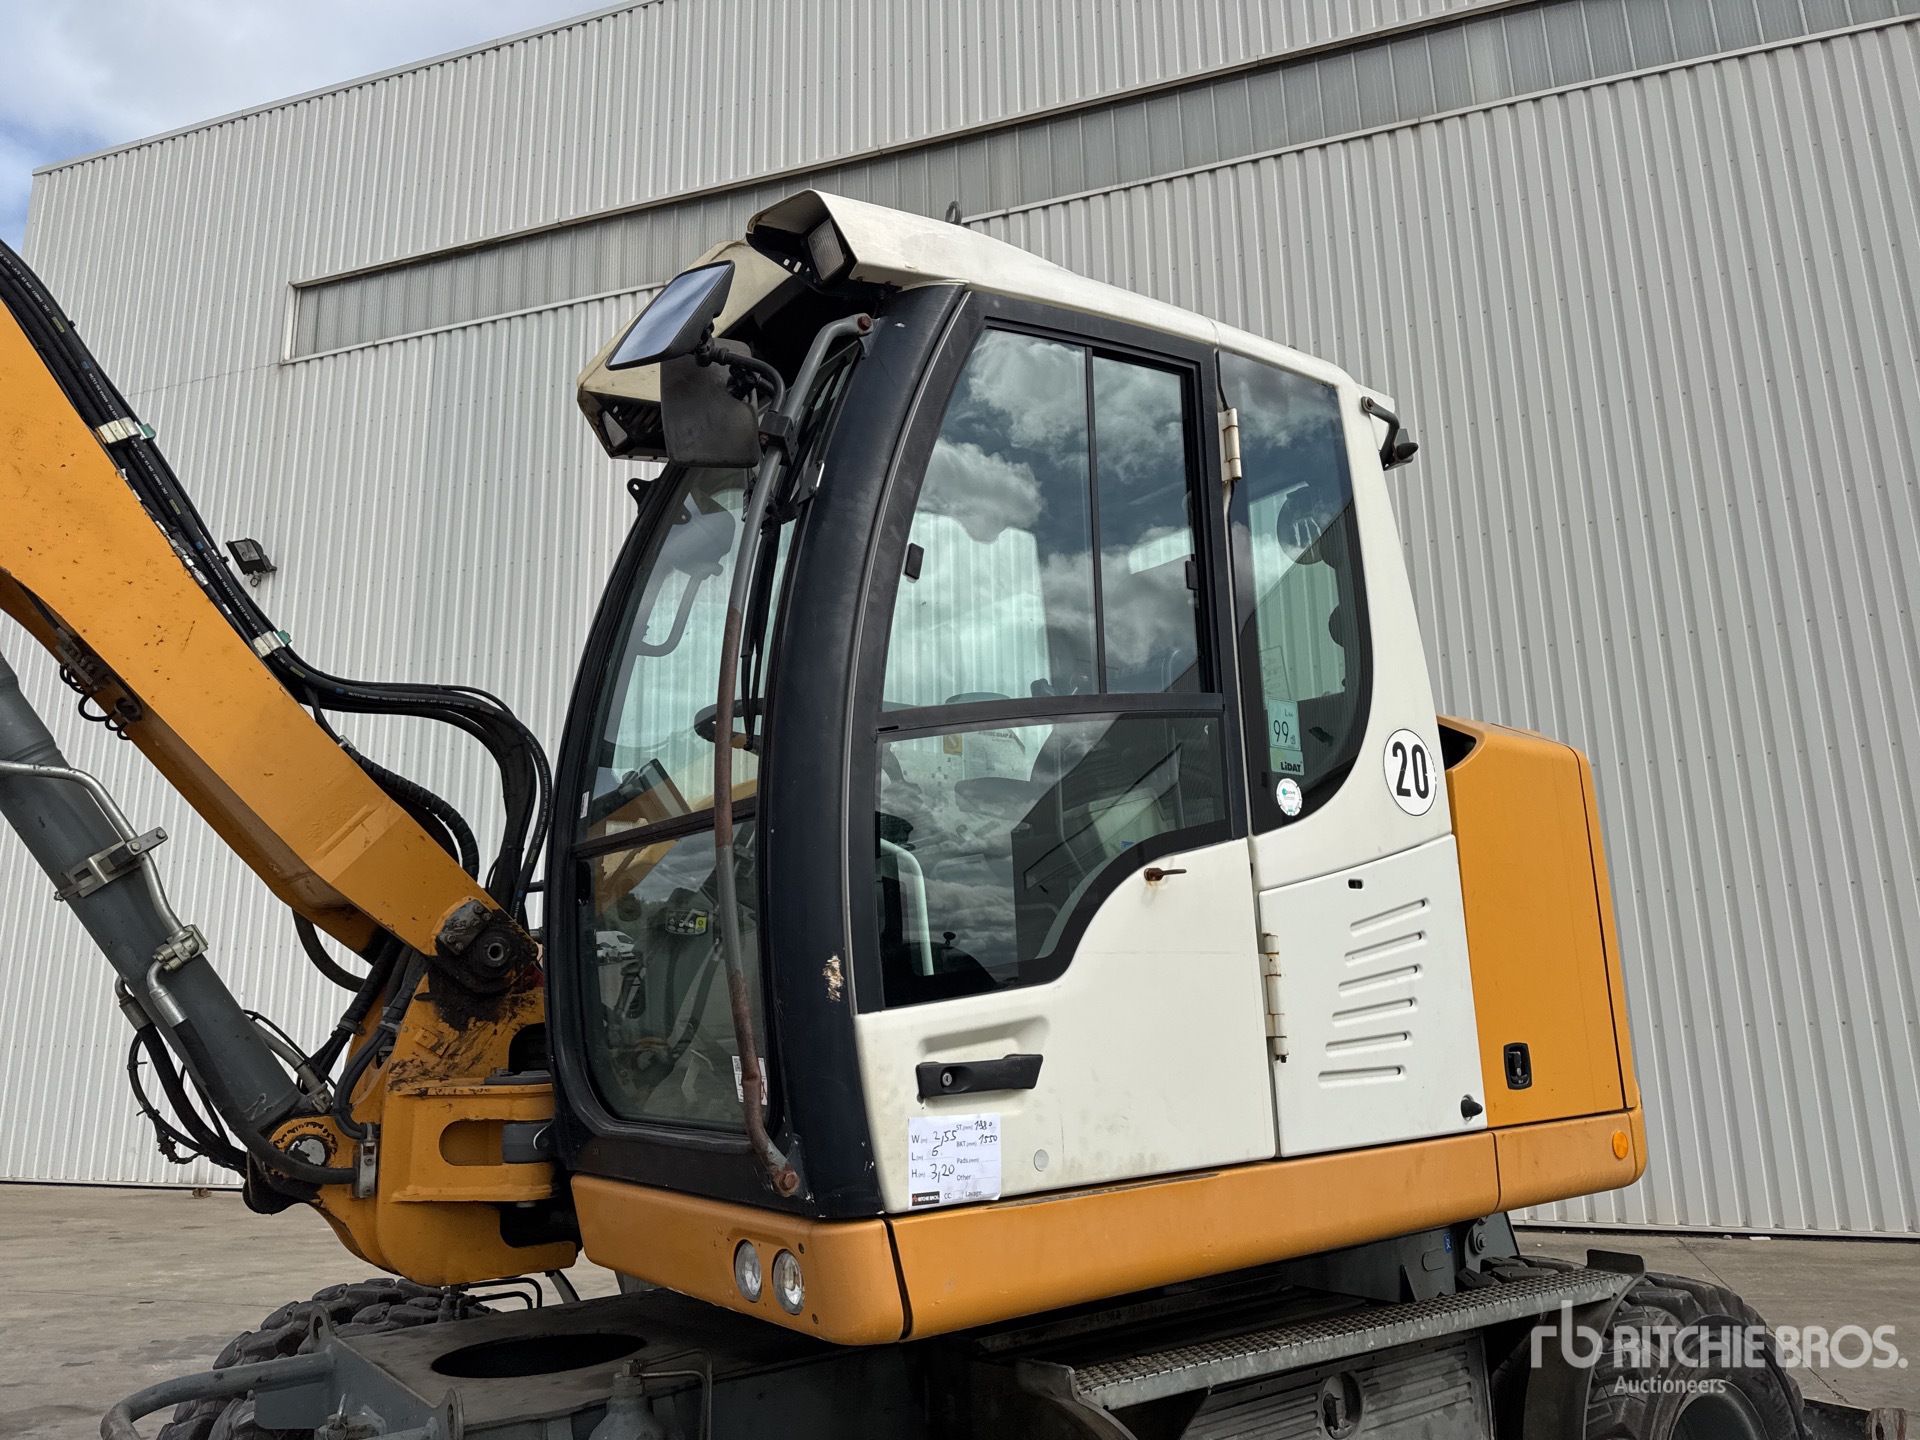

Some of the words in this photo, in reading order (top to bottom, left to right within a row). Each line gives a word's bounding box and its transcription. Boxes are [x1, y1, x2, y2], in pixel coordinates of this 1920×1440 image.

[1273, 719, 1289, 743] 99
[1392, 741, 1429, 800] 20
[978, 1133, 998, 1145] 1550
[929, 1163, 955, 1183] 3,20
